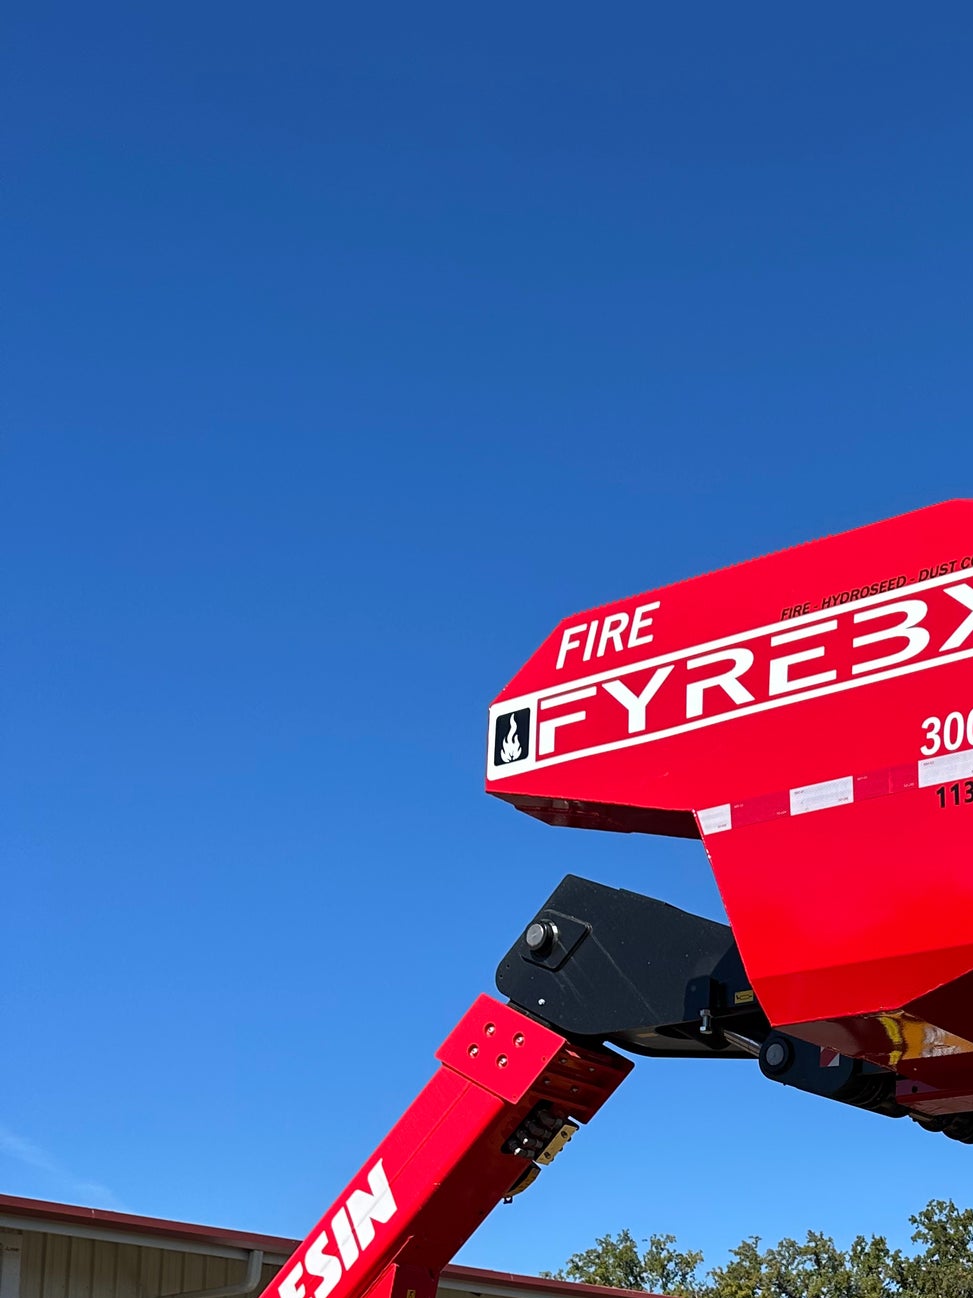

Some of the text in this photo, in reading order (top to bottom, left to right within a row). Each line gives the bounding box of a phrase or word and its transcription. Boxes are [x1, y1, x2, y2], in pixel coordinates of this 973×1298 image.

[781, 603, 811, 621] FIRE
[822, 576, 907, 611] HYDROSEED
[918, 560, 958, 582] DUST
[555, 600, 661, 671] FIRE
